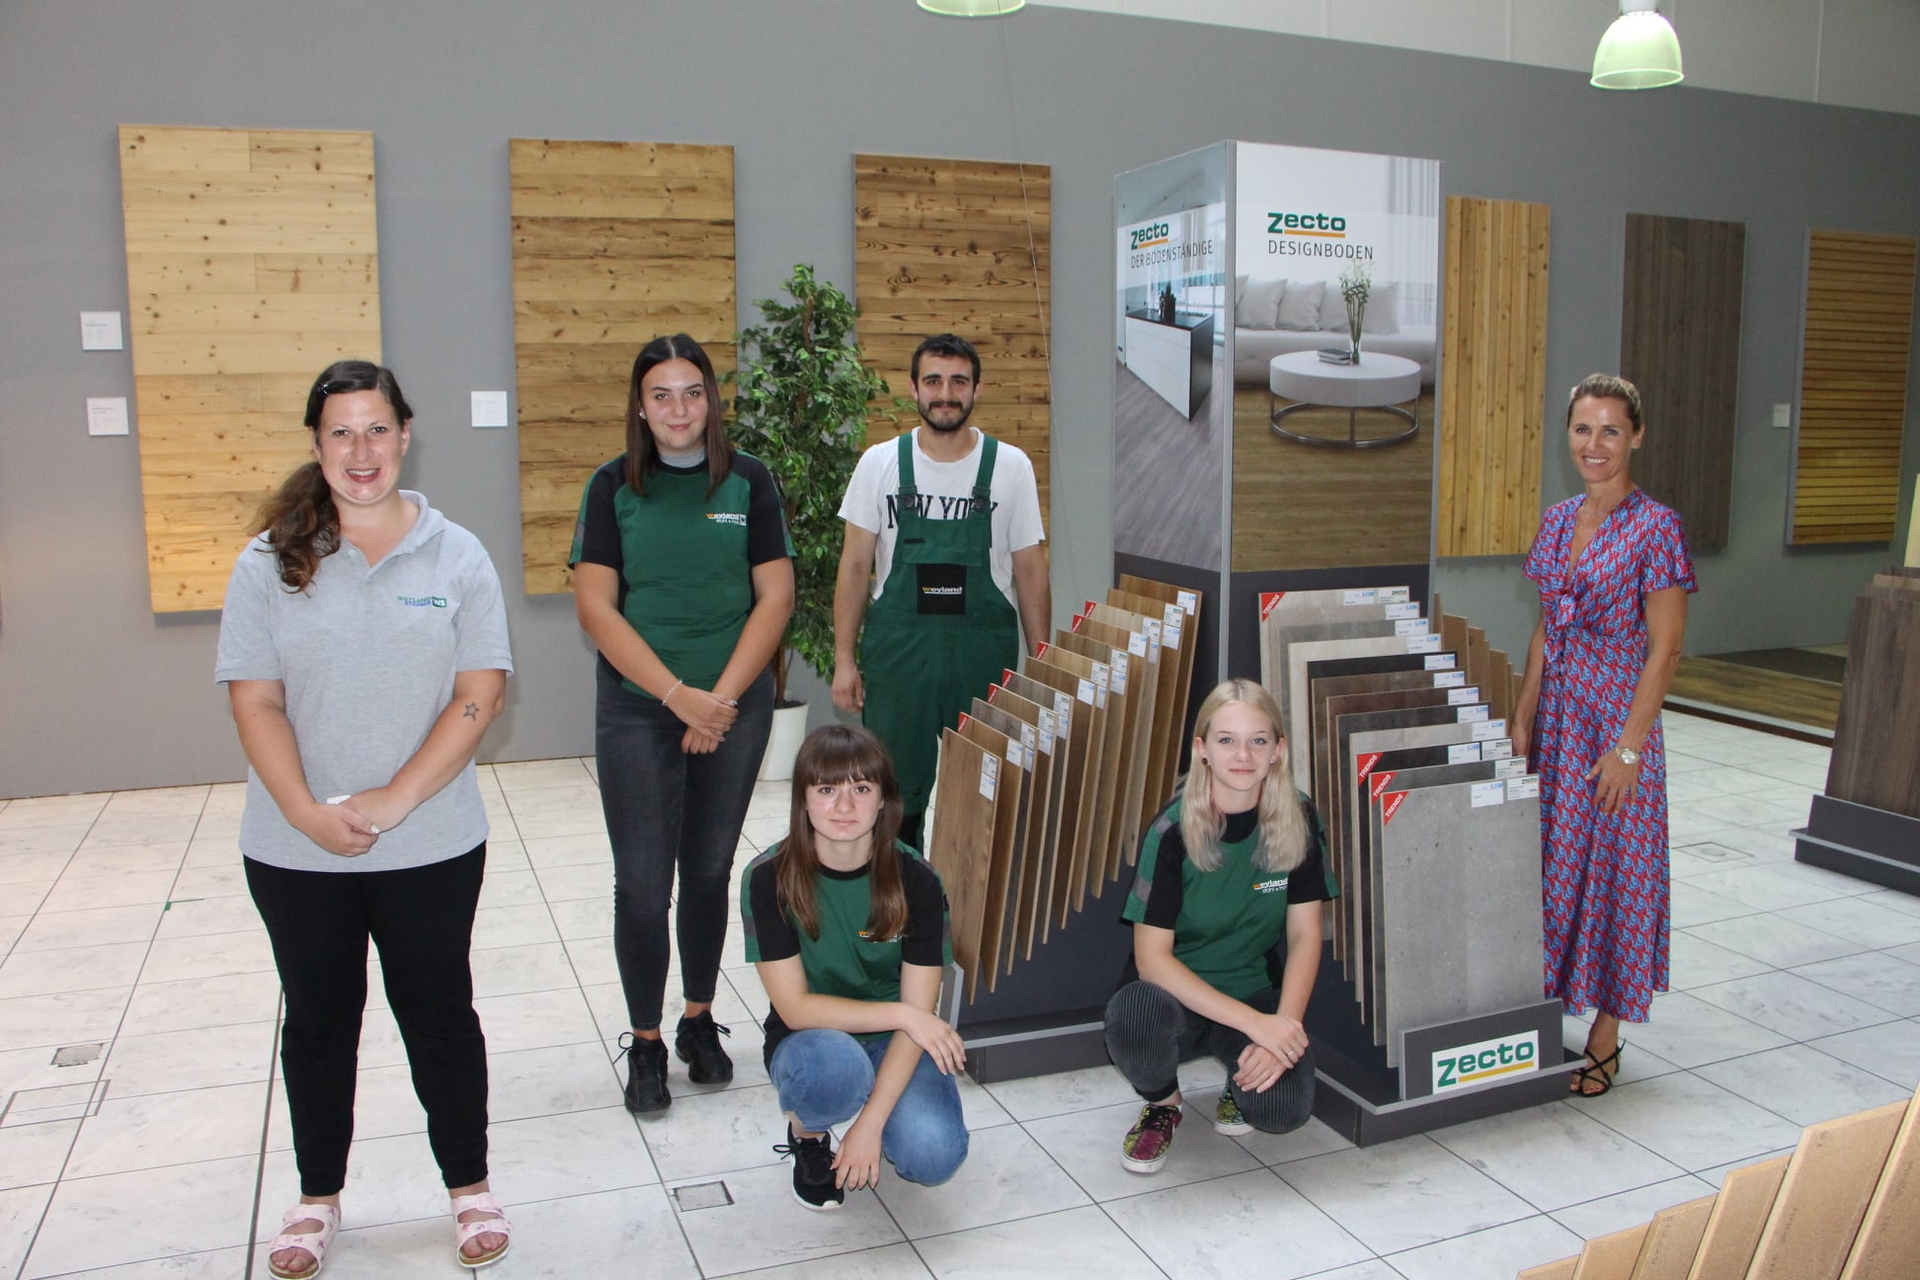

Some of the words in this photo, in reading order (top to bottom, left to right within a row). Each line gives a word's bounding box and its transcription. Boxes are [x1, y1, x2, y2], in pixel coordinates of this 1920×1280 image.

[1131, 254, 1145, 269] DER
[1268, 239, 1373, 260] DESIGNBODEN
[886, 494, 933, 529] NW
[1359, 754, 1378, 778] TRENDS
[1372, 773, 1392, 797] TRENDS
[1385, 793, 1404, 817] TRENDS
